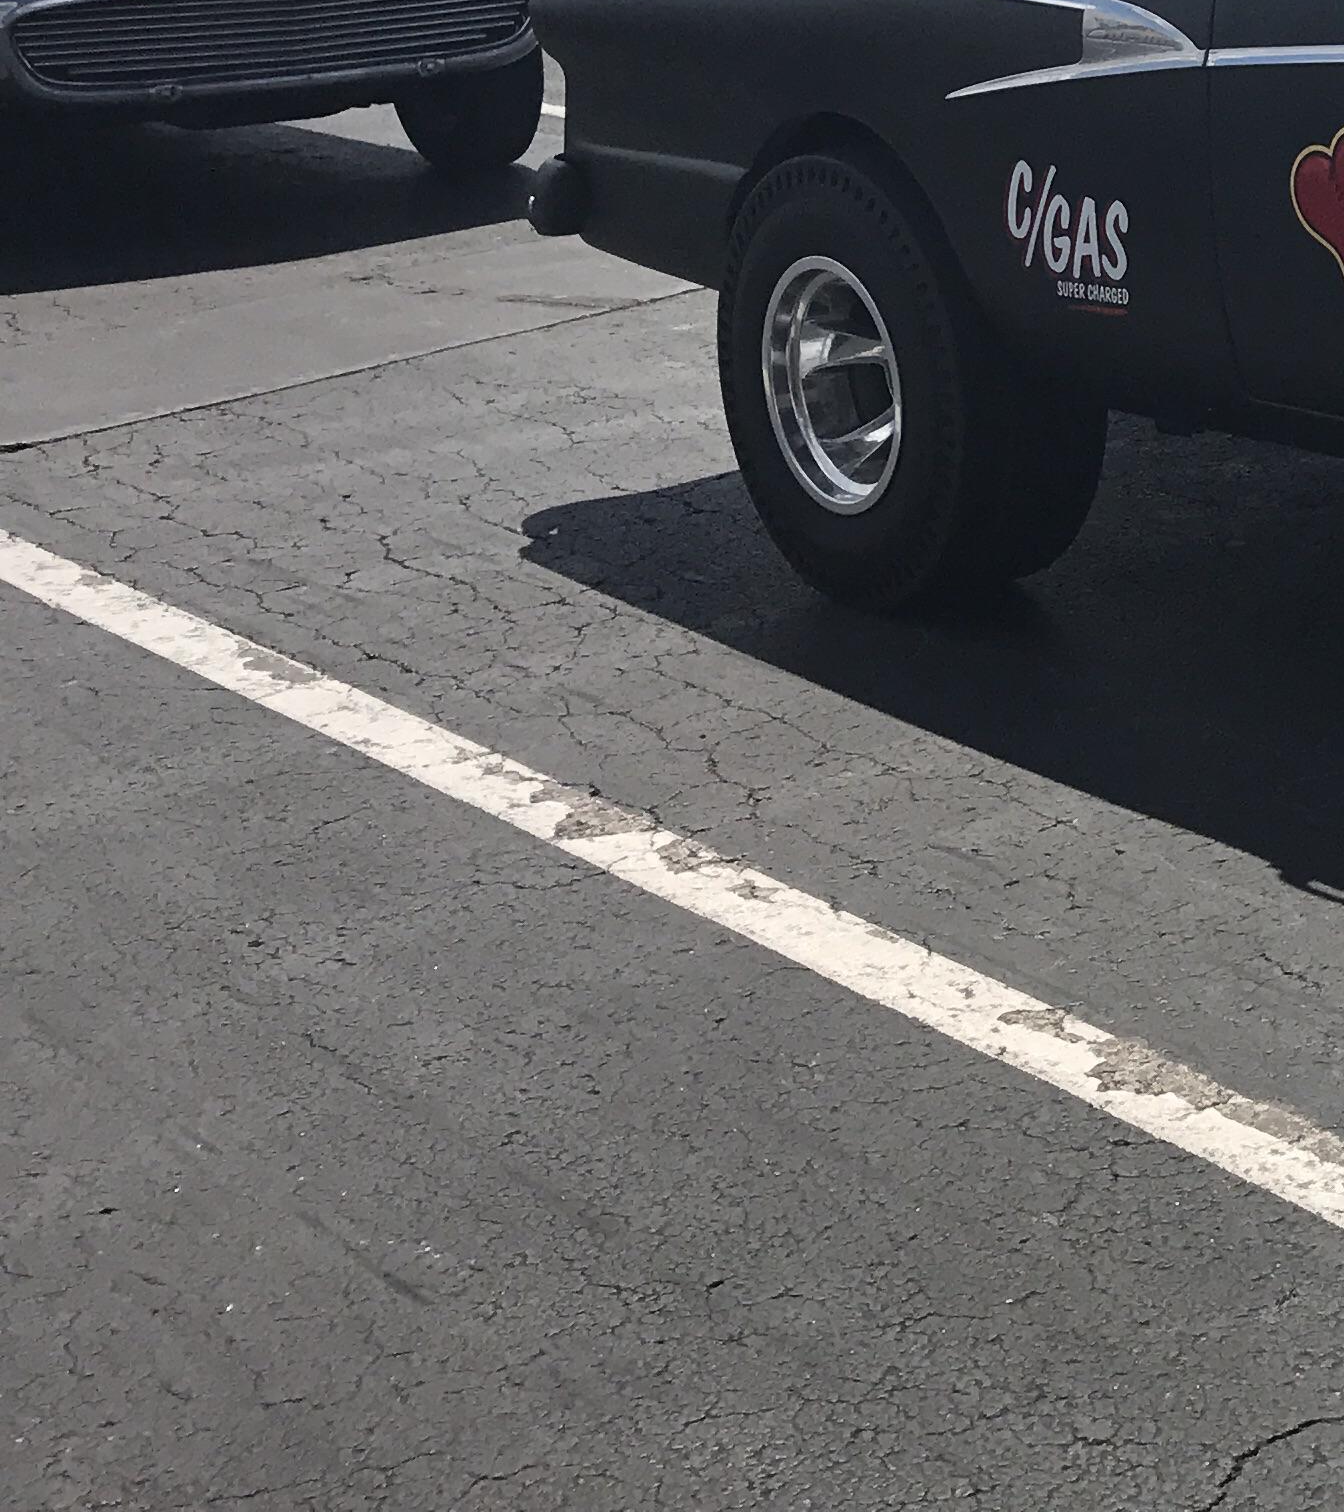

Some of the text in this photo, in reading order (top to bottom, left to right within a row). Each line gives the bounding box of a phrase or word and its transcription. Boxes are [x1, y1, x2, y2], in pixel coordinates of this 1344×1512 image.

[1007, 159, 1129, 281] C/GAS
[1056, 279, 1130, 306] SUPER CHARGED
